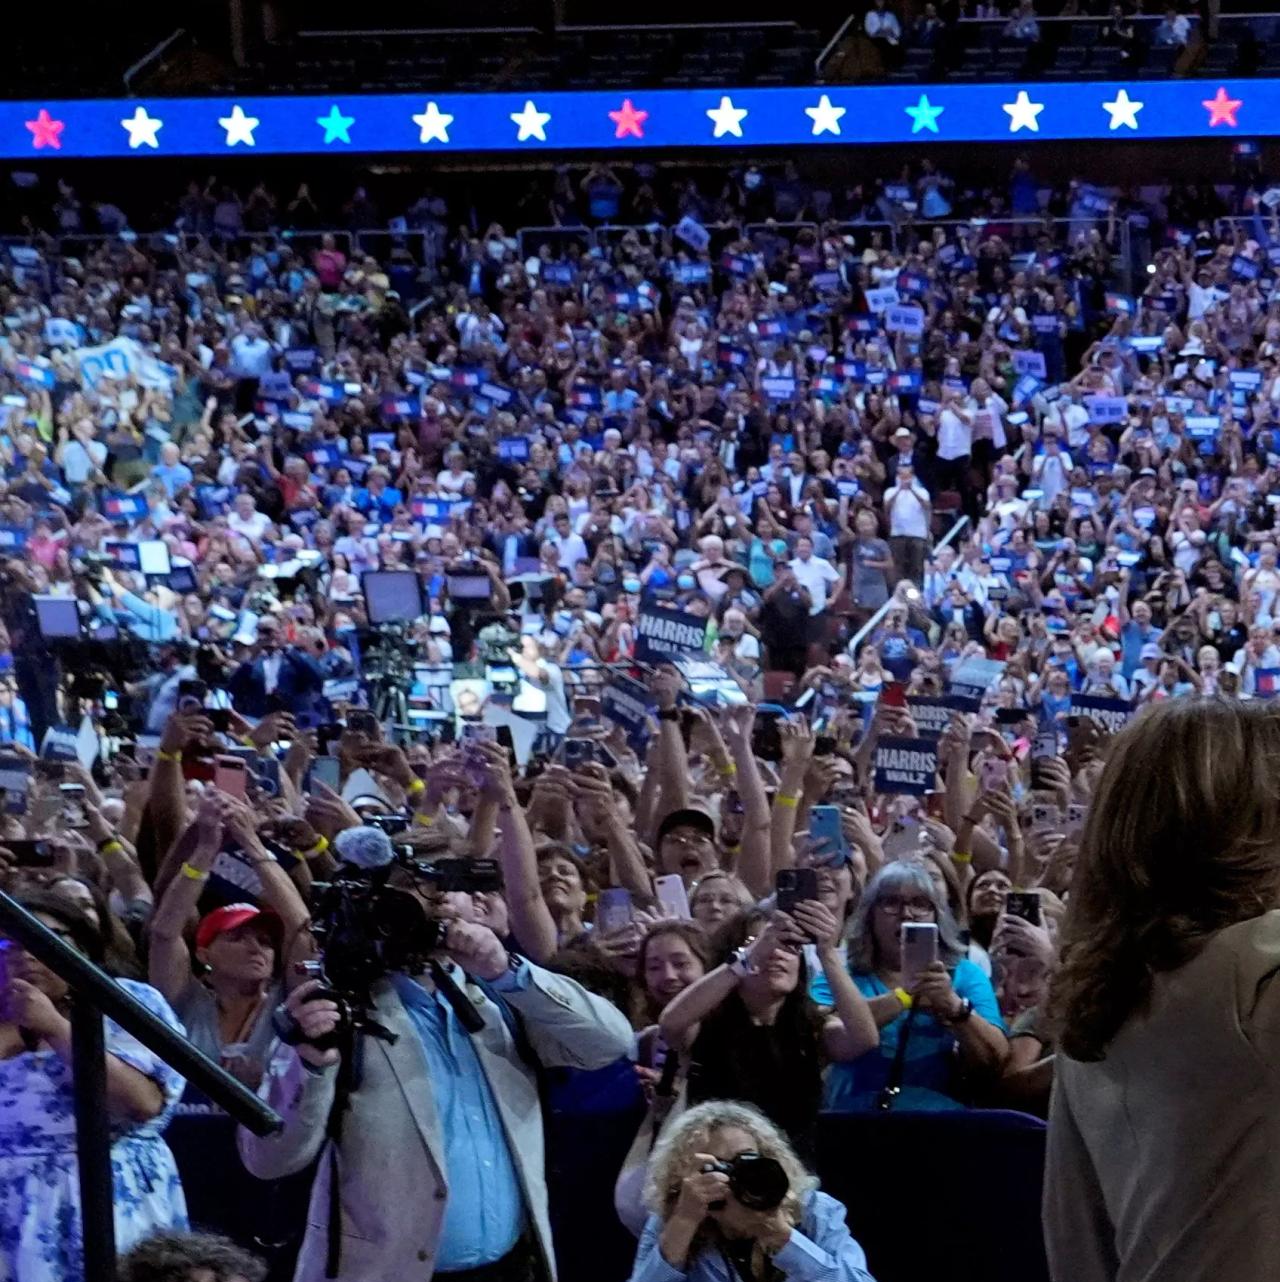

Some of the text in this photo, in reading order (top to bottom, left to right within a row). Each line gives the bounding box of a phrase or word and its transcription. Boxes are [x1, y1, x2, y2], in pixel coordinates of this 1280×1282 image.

[640, 613, 705, 648] HARRIS
[911, 703, 950, 721] ARRIS
[876, 747, 937, 773] HARRIS
[885, 769, 926, 785] WALZ
